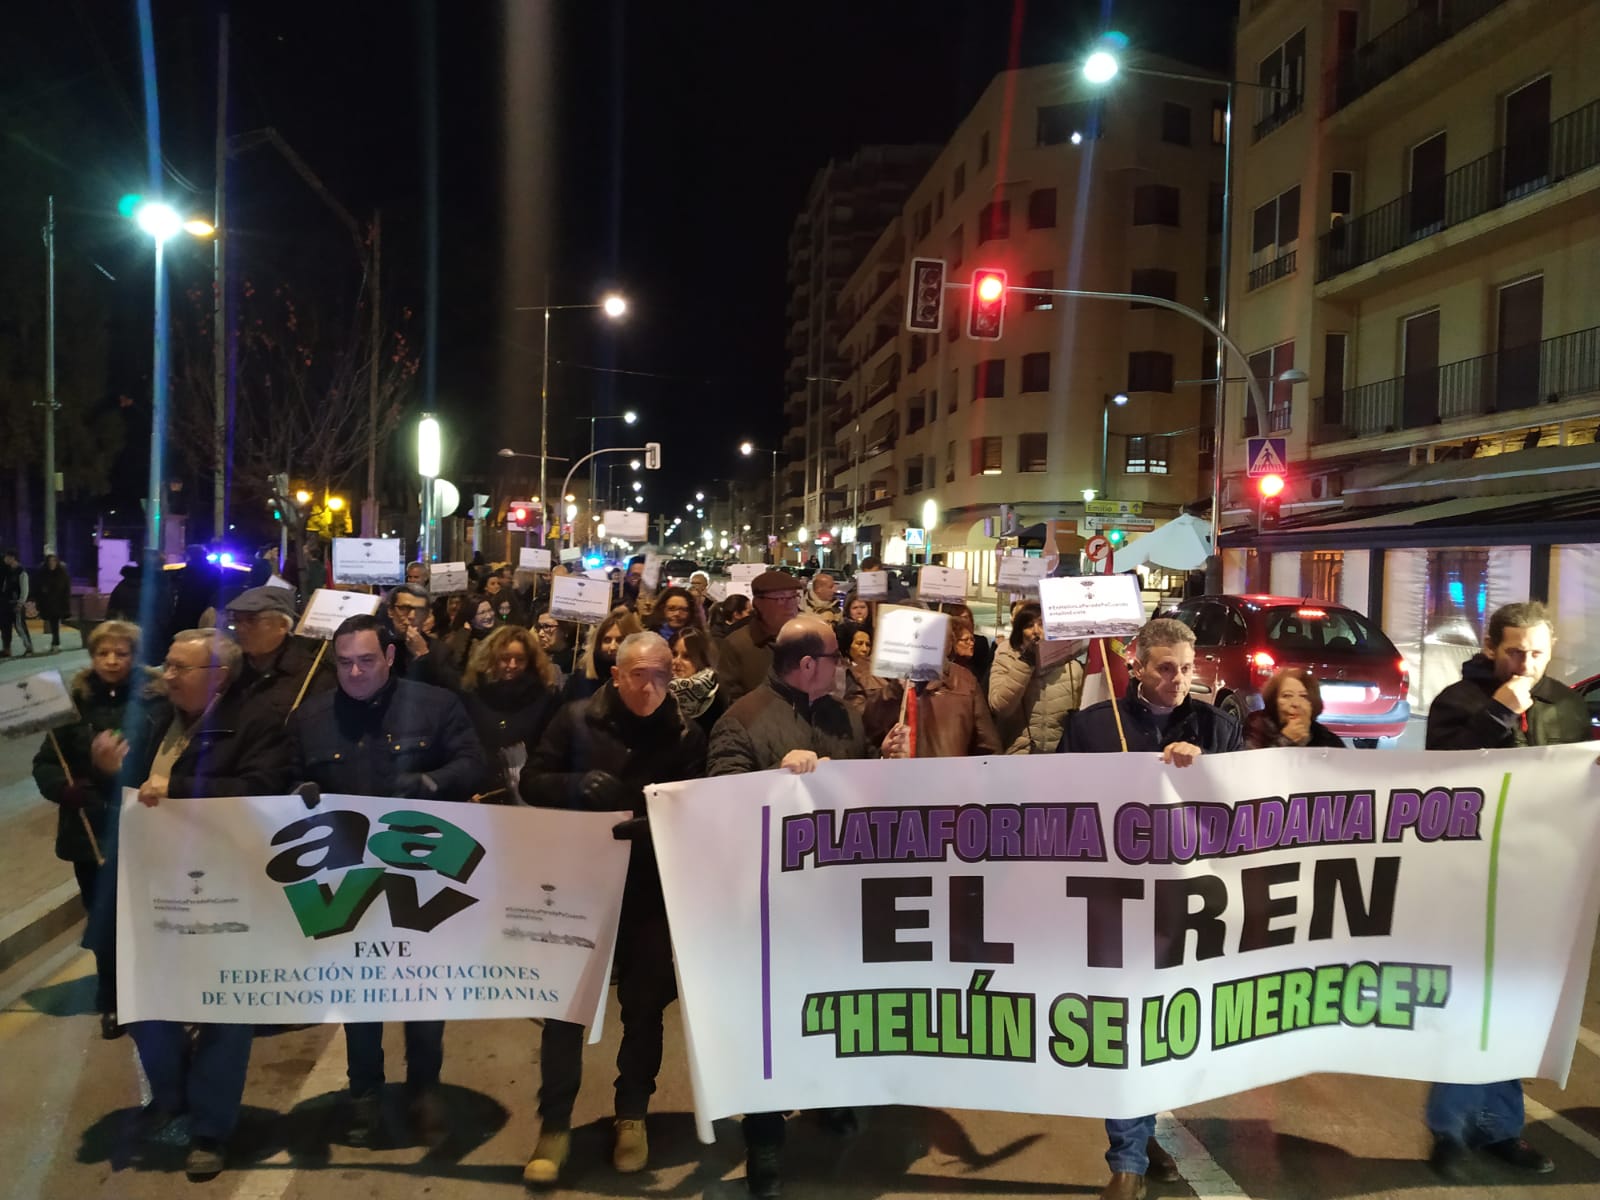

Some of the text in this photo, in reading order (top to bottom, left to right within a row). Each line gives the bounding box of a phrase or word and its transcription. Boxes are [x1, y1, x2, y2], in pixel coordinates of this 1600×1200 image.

[781, 786, 1484, 872] PLATAFORMA CIUDADANA POR
[861, 856, 1401, 969] EL TREN
[219, 962, 540, 984] FEDERACIÓN DE ASOCIACIONES
[354, 941, 412, 958] FAVE
[201, 983, 559, 1006] DE VECINOS DE HELLÍN Y PEDANIAS
[802, 960, 1452, 1069] “HELLÍN SE LO MERECE”
